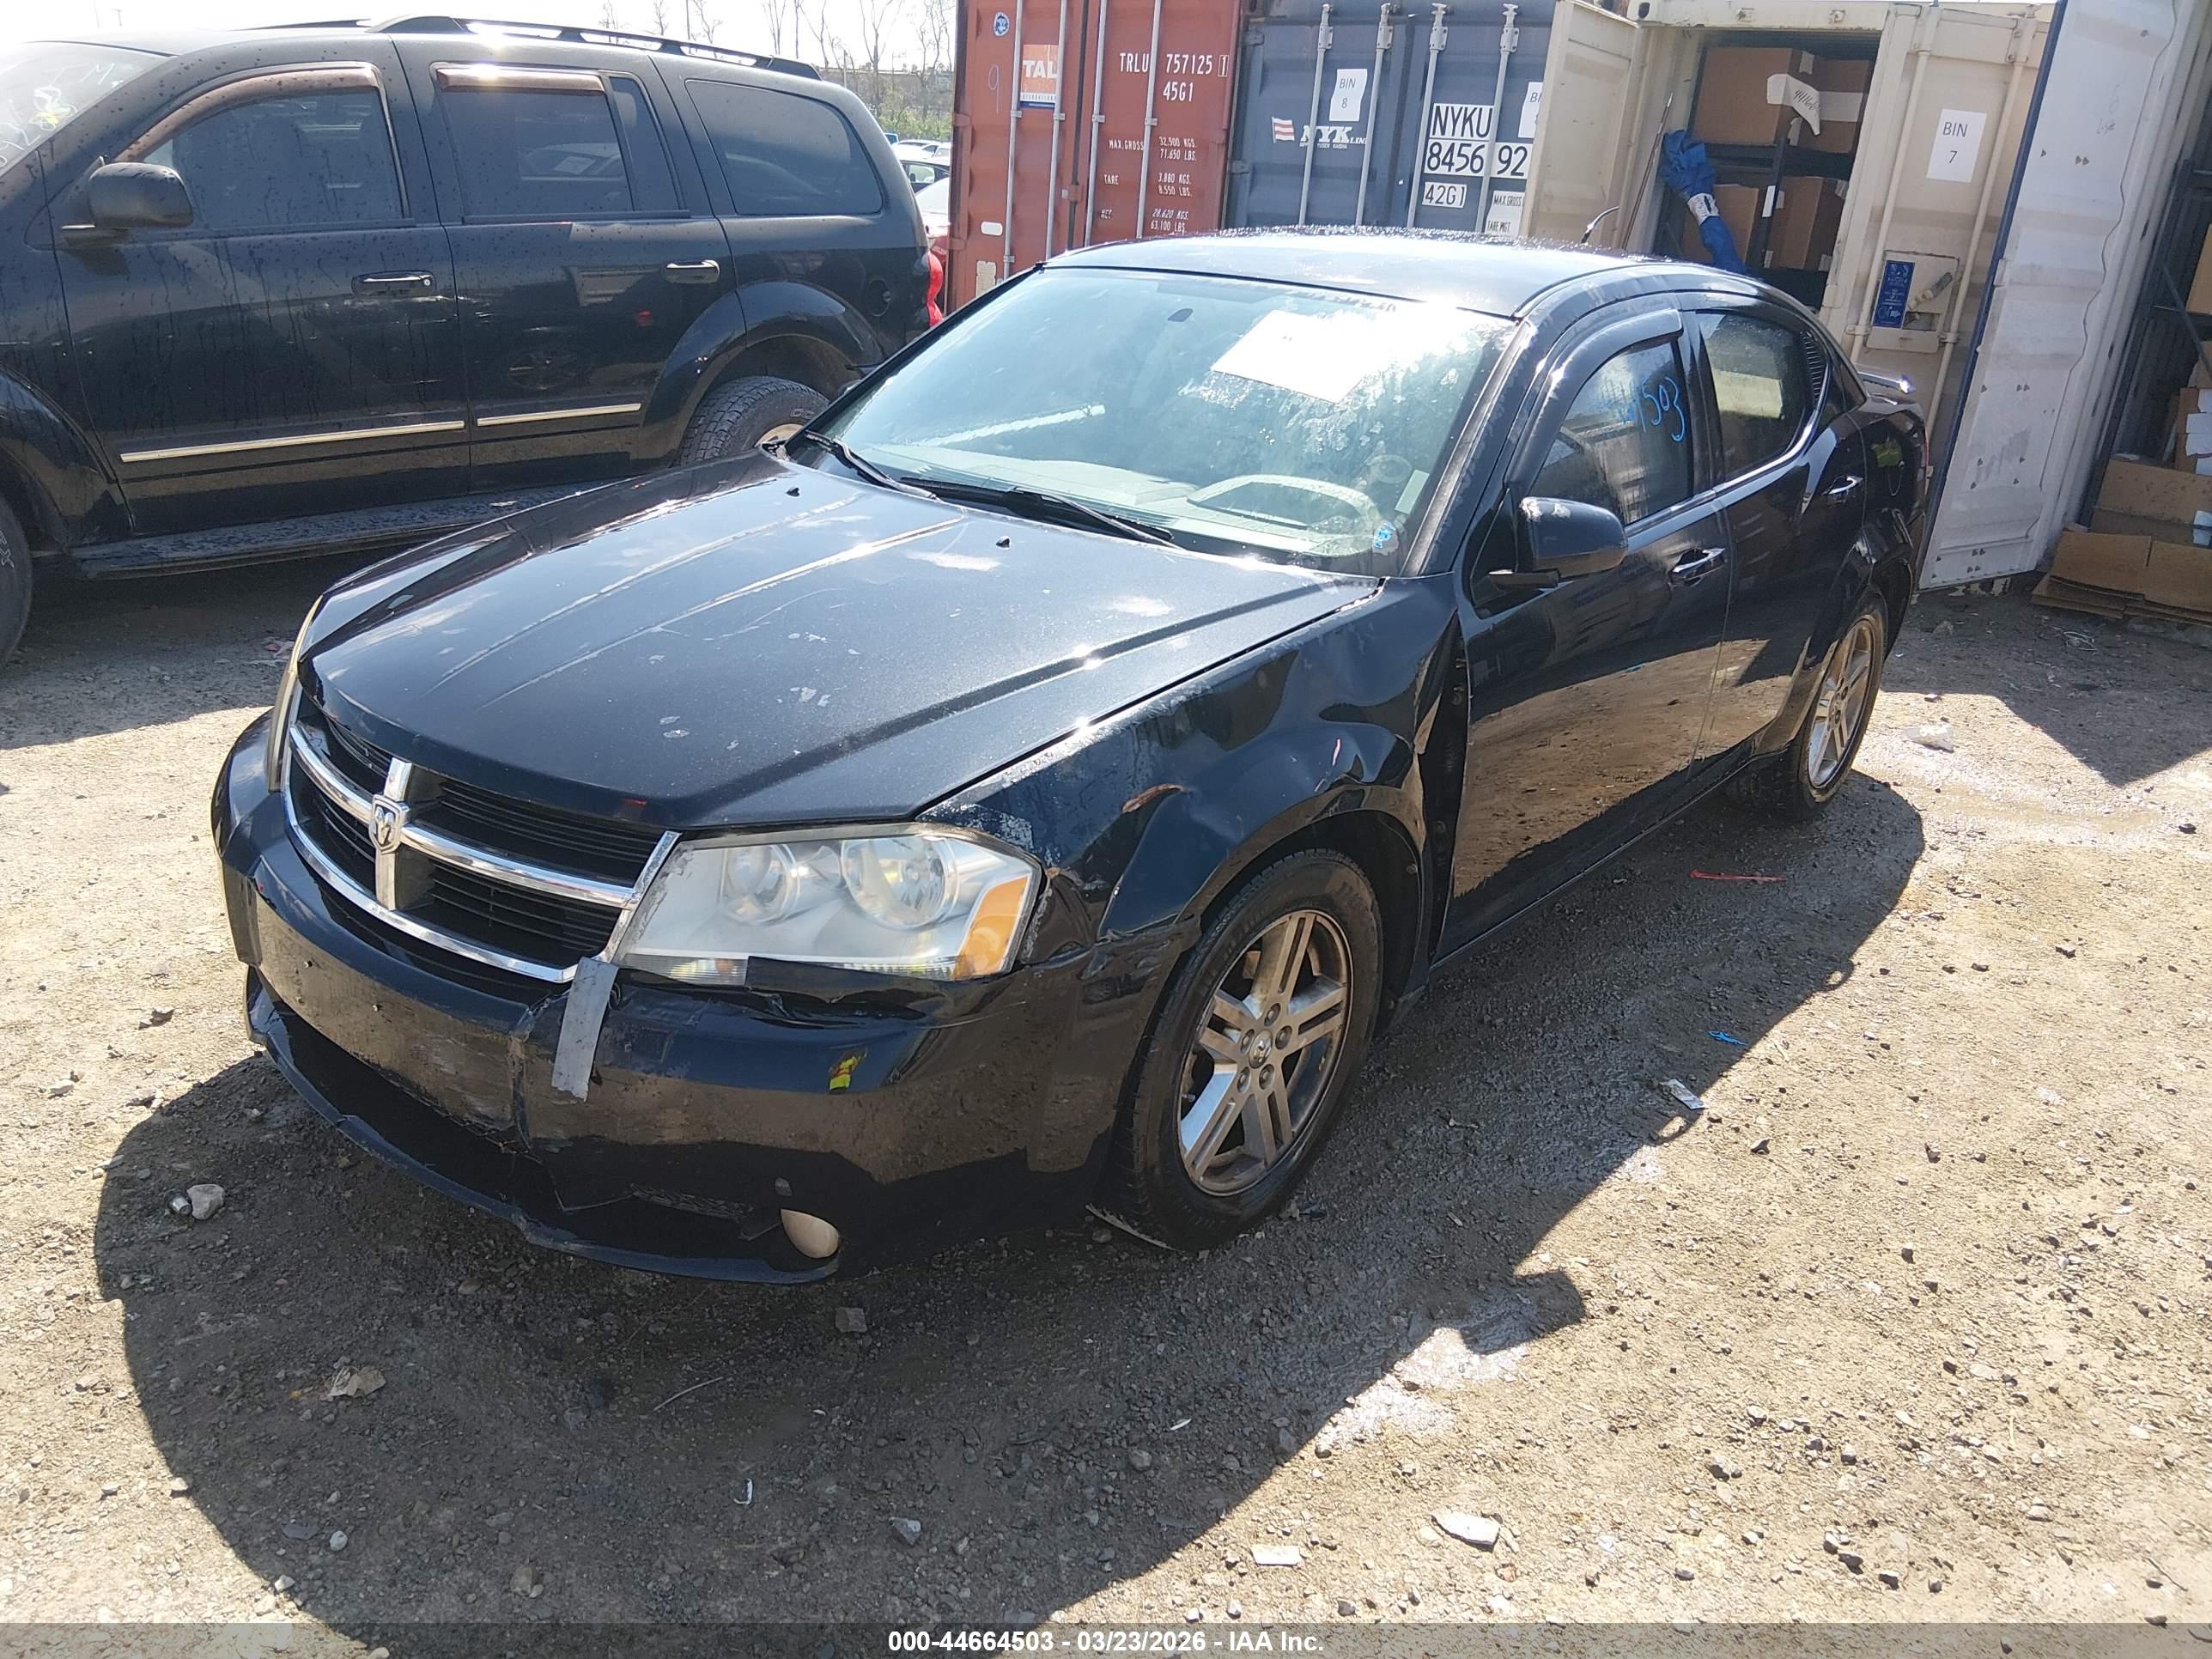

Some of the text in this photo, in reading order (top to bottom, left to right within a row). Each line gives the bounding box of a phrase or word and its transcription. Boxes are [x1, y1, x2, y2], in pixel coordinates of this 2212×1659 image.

[1023, 60, 1057, 78] TAL
[1120, 52, 1149, 73] TRLU
[1166, 54, 1212, 75] 757125
[1163, 81, 1194, 102] 45G1
[1340, 78, 1356, 89] BIN
[1341, 97, 1348, 108] 8
[1529, 92, 1541, 102] BI
[1431, 106, 1493, 138] NYKU
[1942, 121, 1968, 137] BIN
[1948, 149, 1958, 164] 7
[1104, 173, 1120, 185] TARE
[1425, 185, 1465, 206] 42G1
